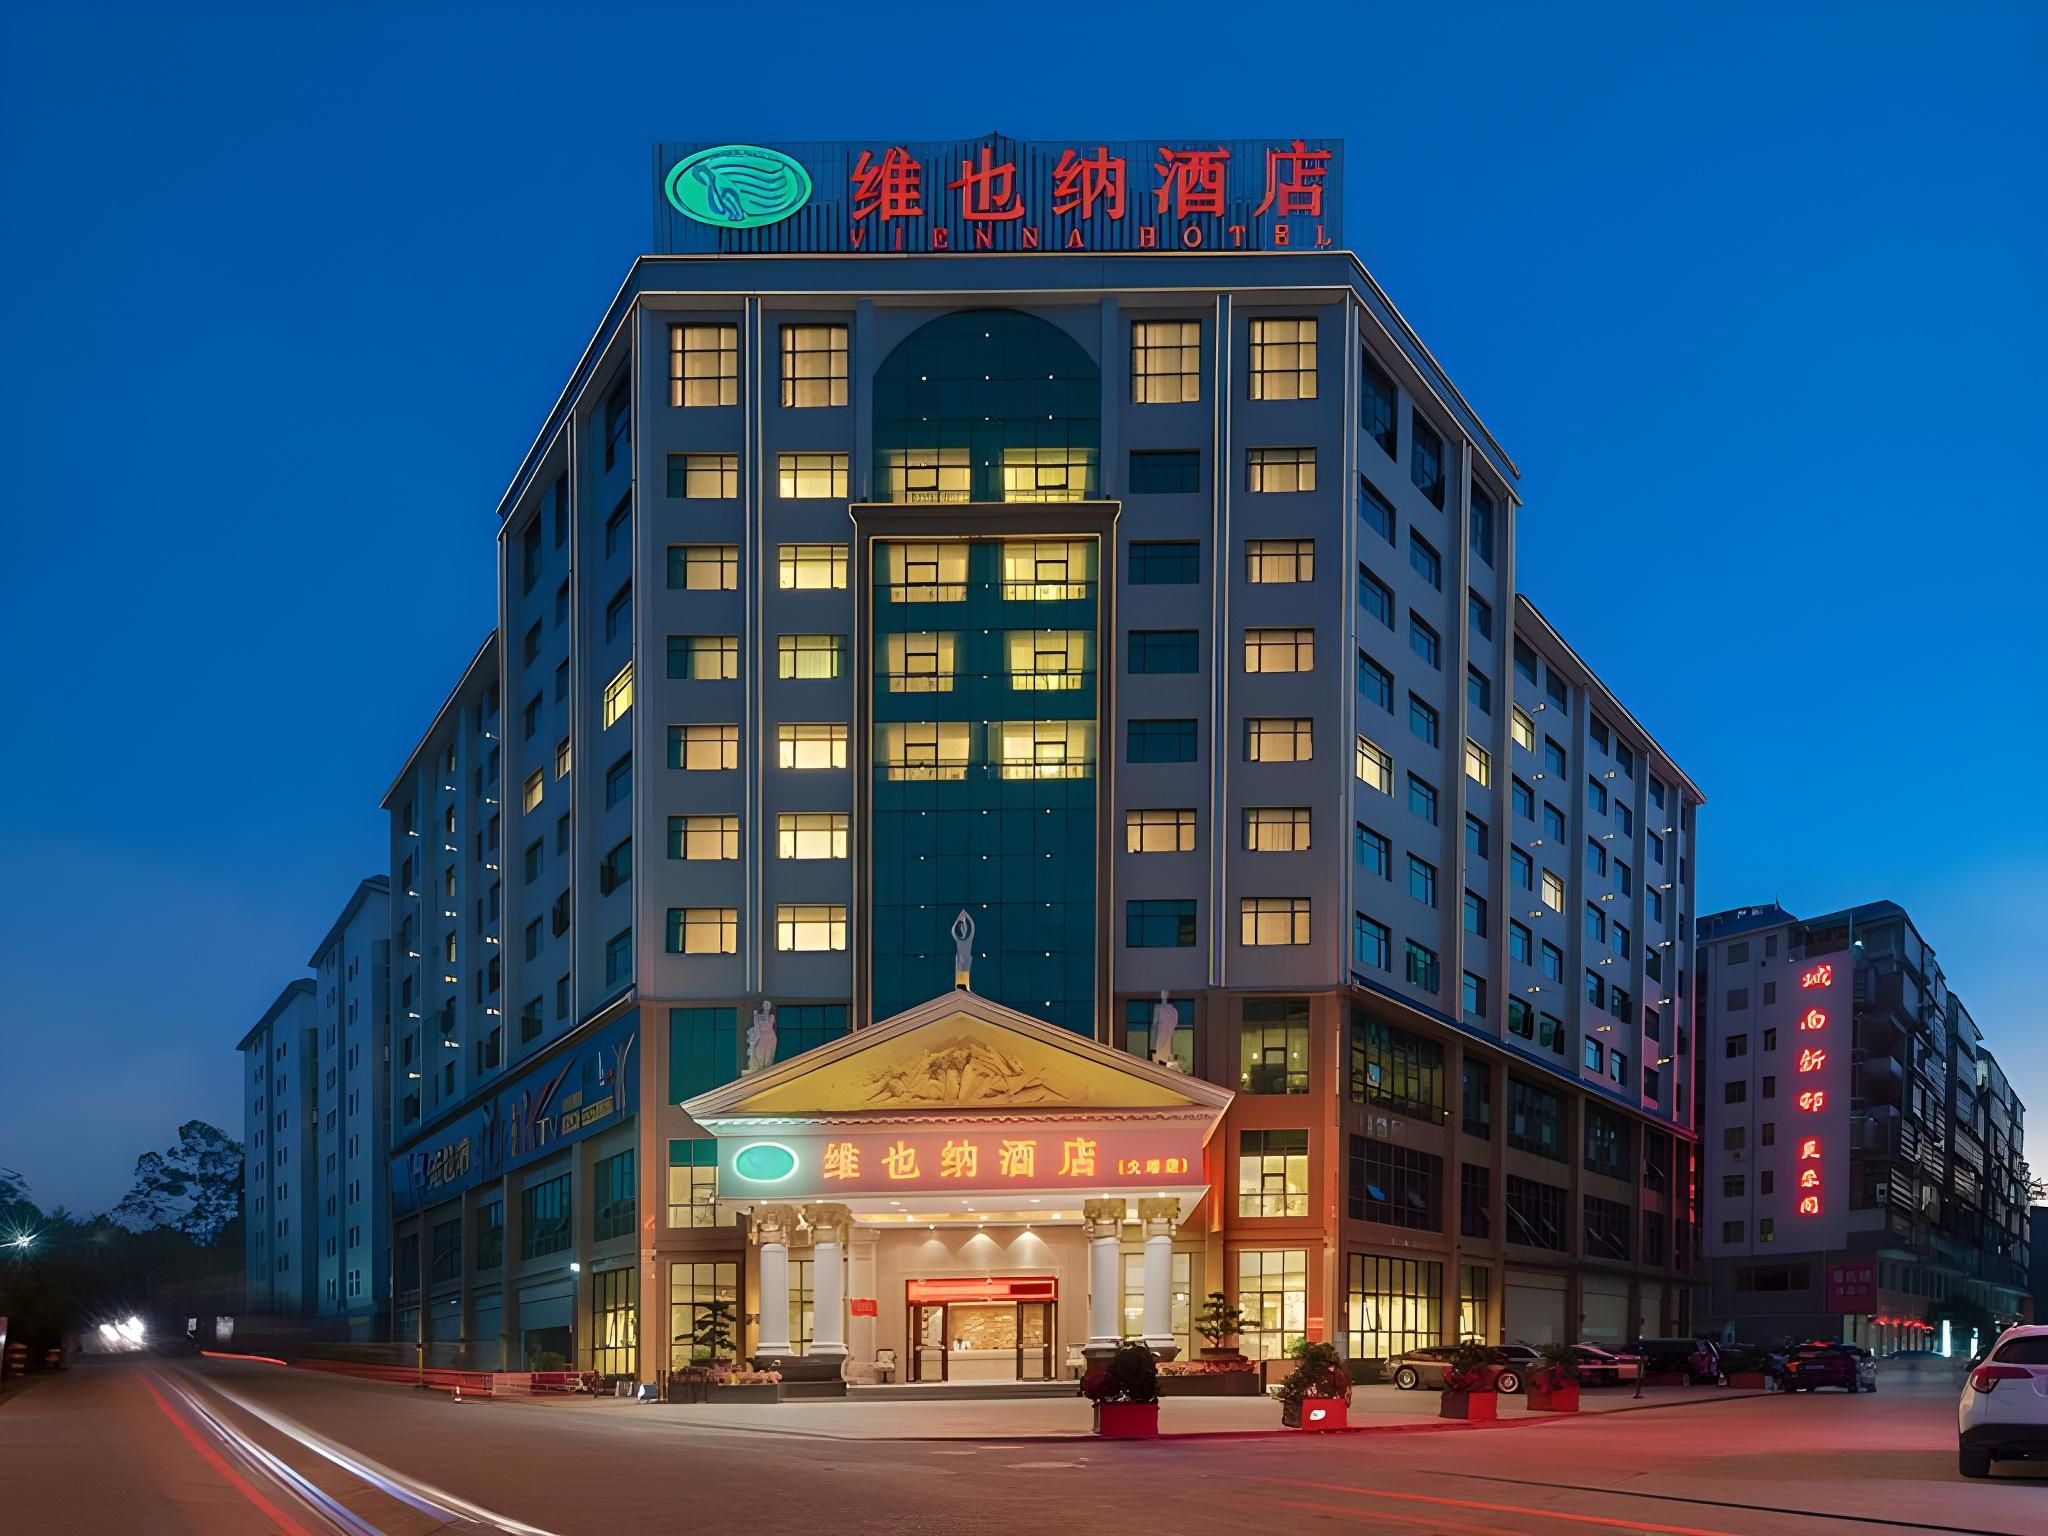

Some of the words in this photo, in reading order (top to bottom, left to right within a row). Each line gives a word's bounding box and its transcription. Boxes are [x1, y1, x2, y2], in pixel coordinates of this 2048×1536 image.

[849, 140, 1332, 222] 维也纳酒店
[849, 226, 1086, 250] VIENNA
[1138, 223, 1333, 249] HOTEL
[822, 1135, 1098, 1181] 维也纳酒店
